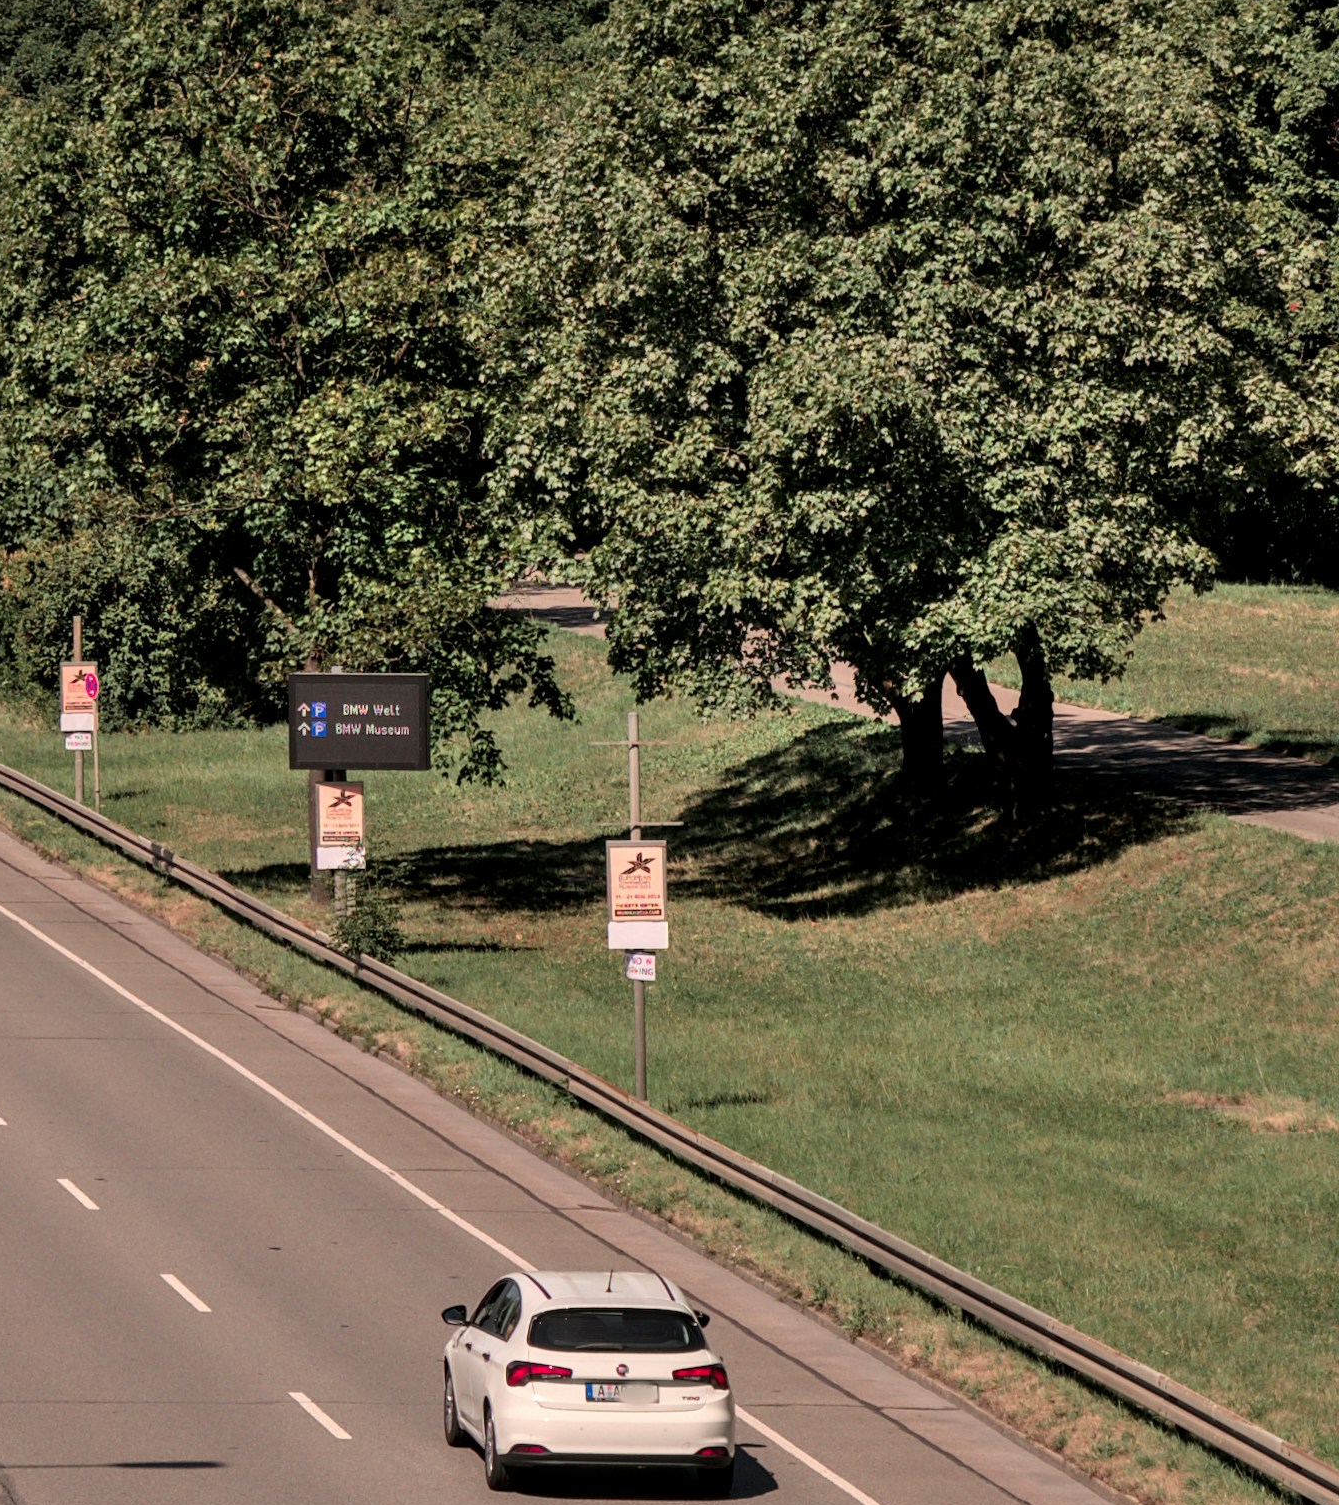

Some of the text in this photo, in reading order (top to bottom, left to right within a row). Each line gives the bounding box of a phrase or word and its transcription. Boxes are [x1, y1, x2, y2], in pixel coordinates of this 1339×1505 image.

[343, 704, 369, 716] BMW
[373, 704, 400, 717] Welt
[335, 723, 361, 735] BMW
[365, 723, 410, 736] Museum
